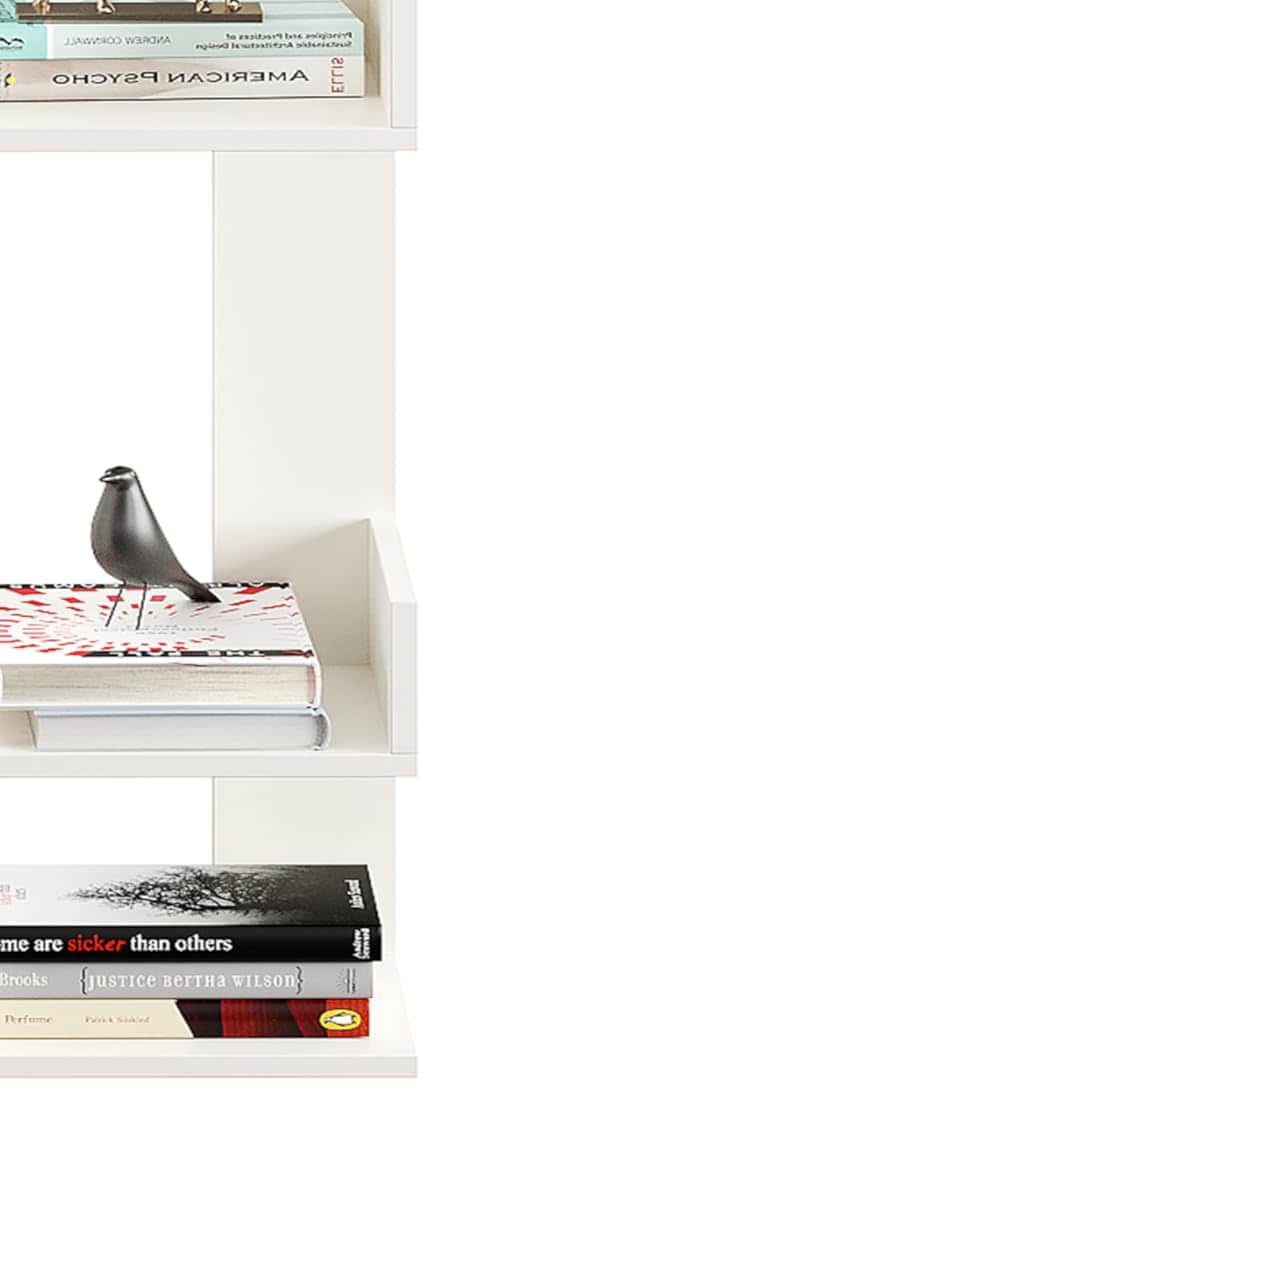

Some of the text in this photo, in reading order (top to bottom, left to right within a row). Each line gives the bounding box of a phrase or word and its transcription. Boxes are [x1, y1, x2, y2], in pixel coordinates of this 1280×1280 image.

[33, 938, 64, 952] are
[67, 934, 126, 952] sicker
[130, 935, 171, 952] than
[174, 935, 234, 952] others
